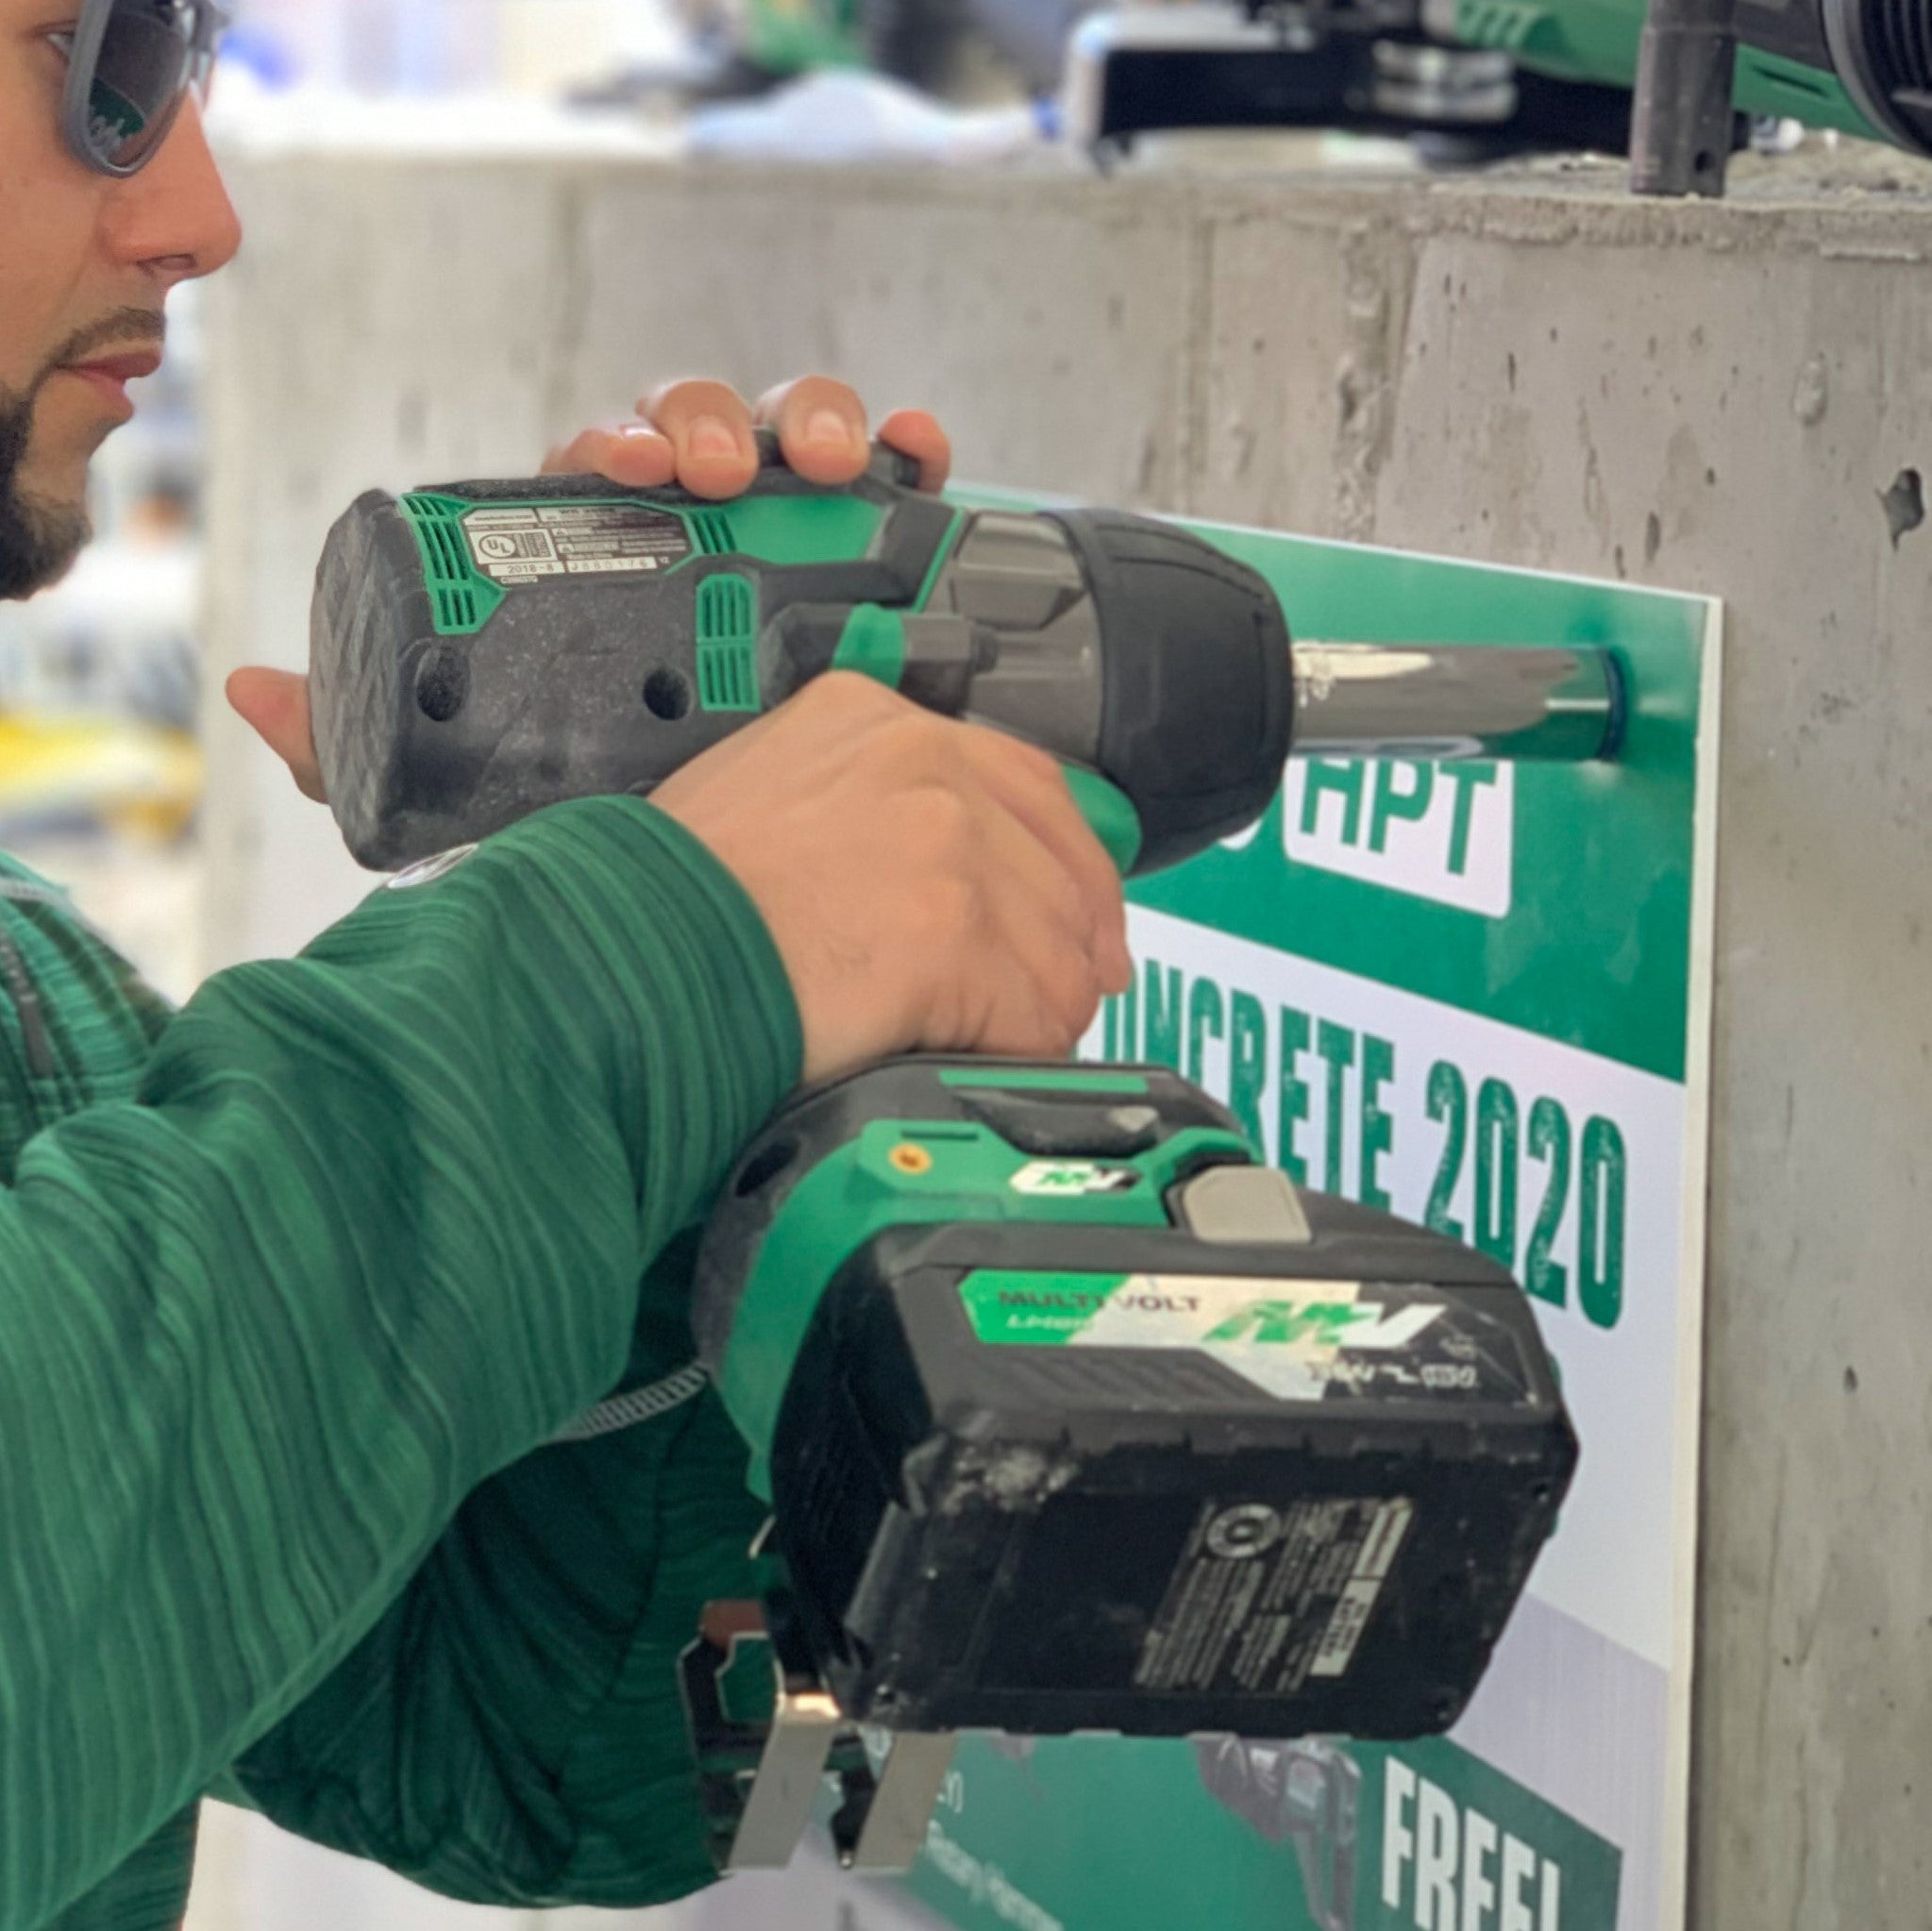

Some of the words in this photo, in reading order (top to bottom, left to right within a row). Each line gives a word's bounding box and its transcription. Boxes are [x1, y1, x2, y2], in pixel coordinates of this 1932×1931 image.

[486, 538, 512, 554] UL
[1300, 757, 1498, 877] HPT
[1102, 958, 1394, 1212] NCRETE
[1423, 1059, 1626, 1329] 2020
[1115, 1295, 1201, 1313] VOLT
